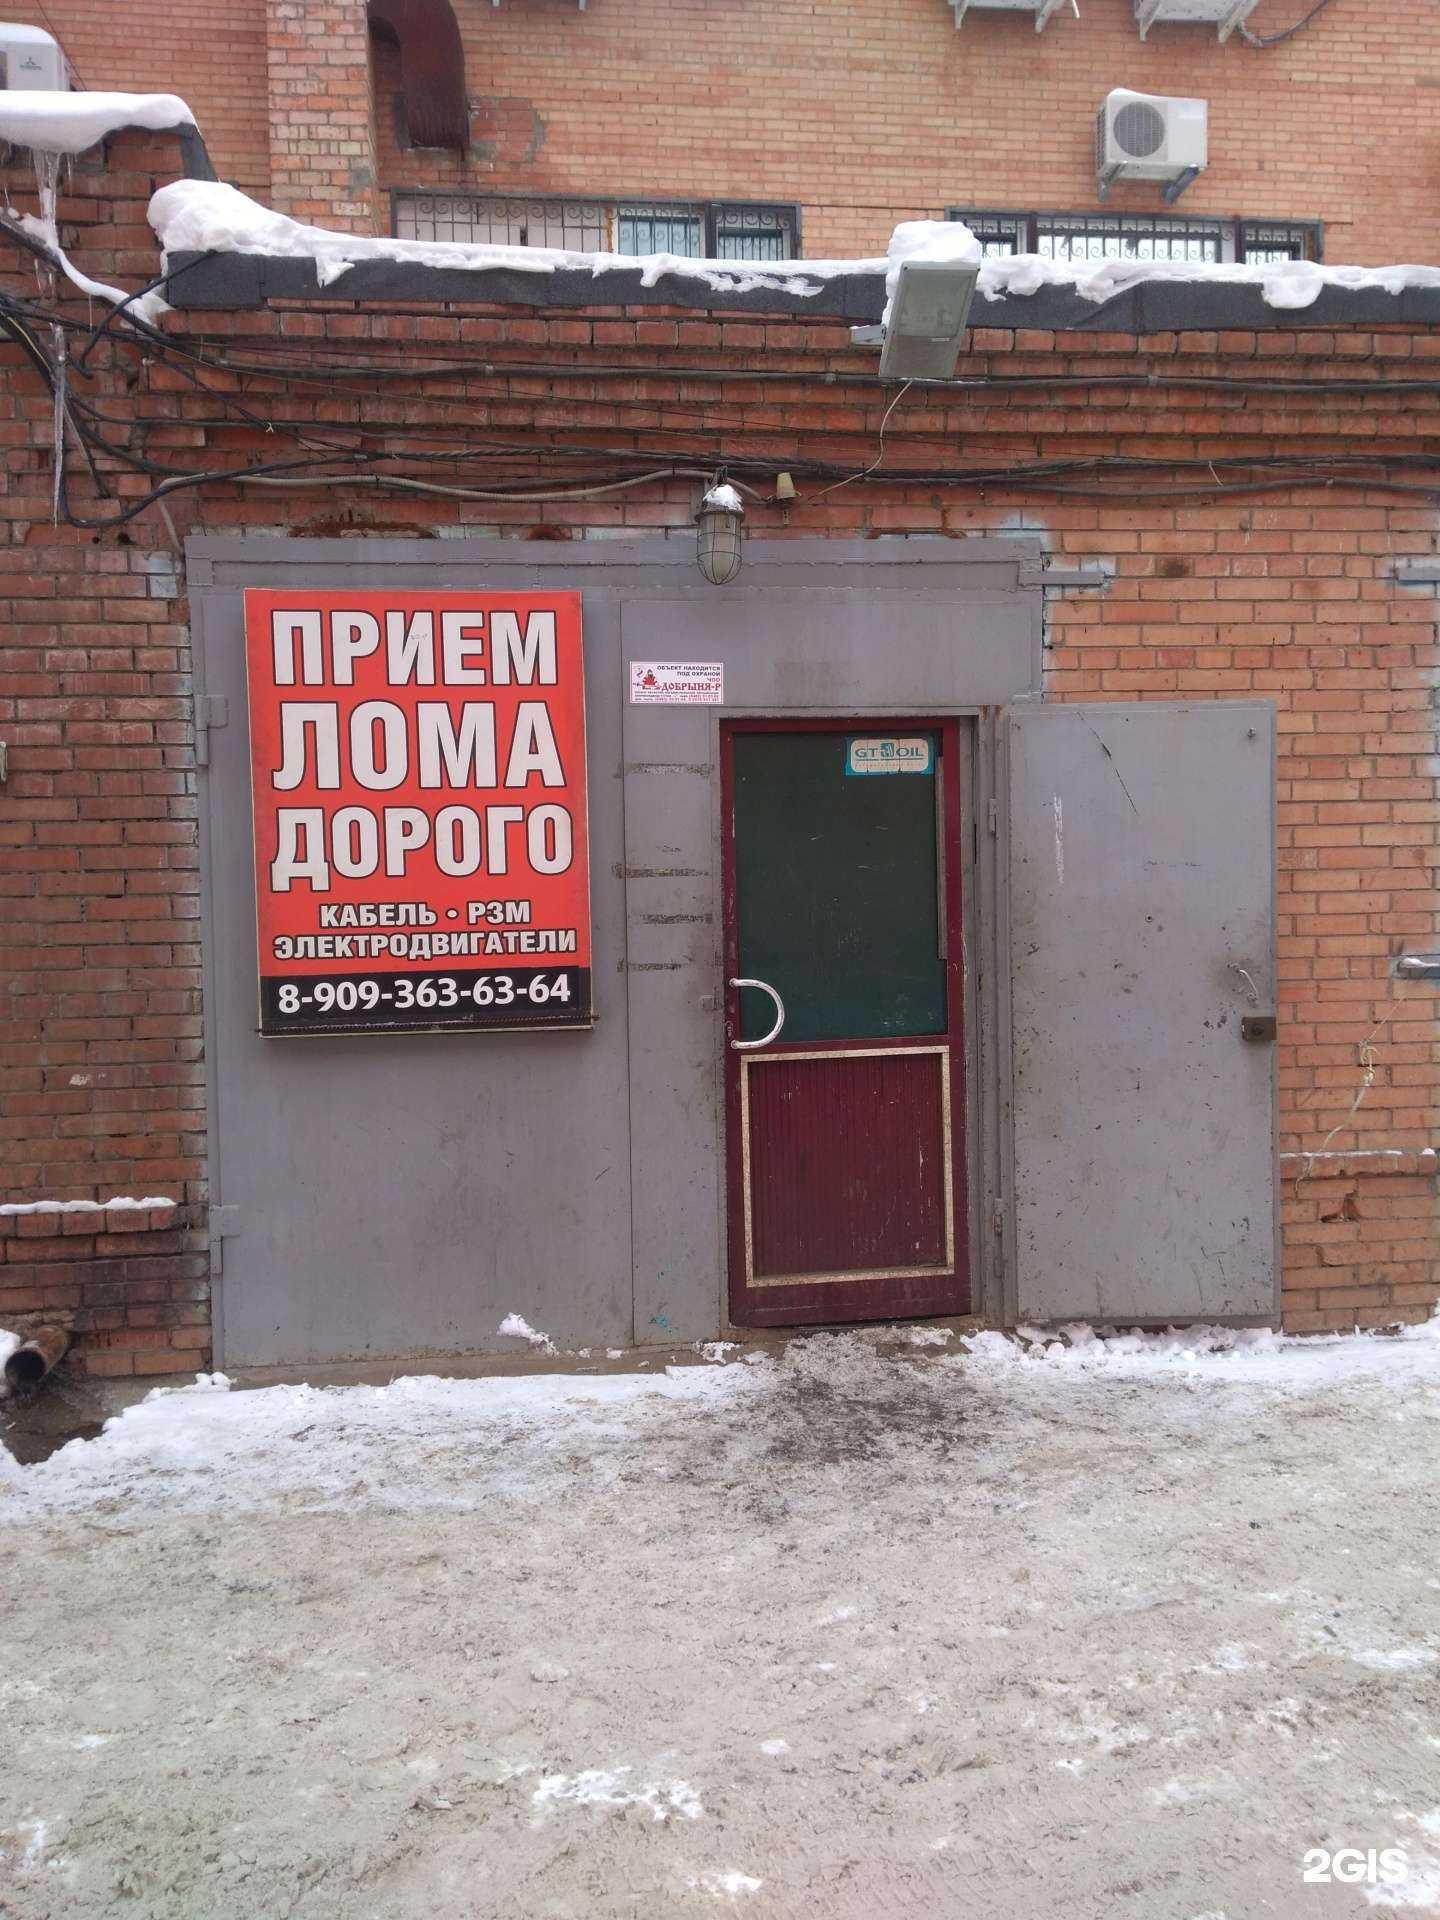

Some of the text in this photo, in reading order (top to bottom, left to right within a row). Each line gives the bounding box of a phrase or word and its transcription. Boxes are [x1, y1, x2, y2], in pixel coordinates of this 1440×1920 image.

[270, 608, 559, 686] ПРИЕМ
[270, 699, 567, 792] ЛОМА
[855, 747, 924, 758] GT OIL
[269, 803, 574, 892] ДОРОГО
[319, 900, 532, 928] КАБЕЛЬ РЗМ
[272, 928, 578, 961] ЭЛЕКТРОДВИГАТЕЛИ
[277, 973, 571, 1014] 8-909-363-63-64
